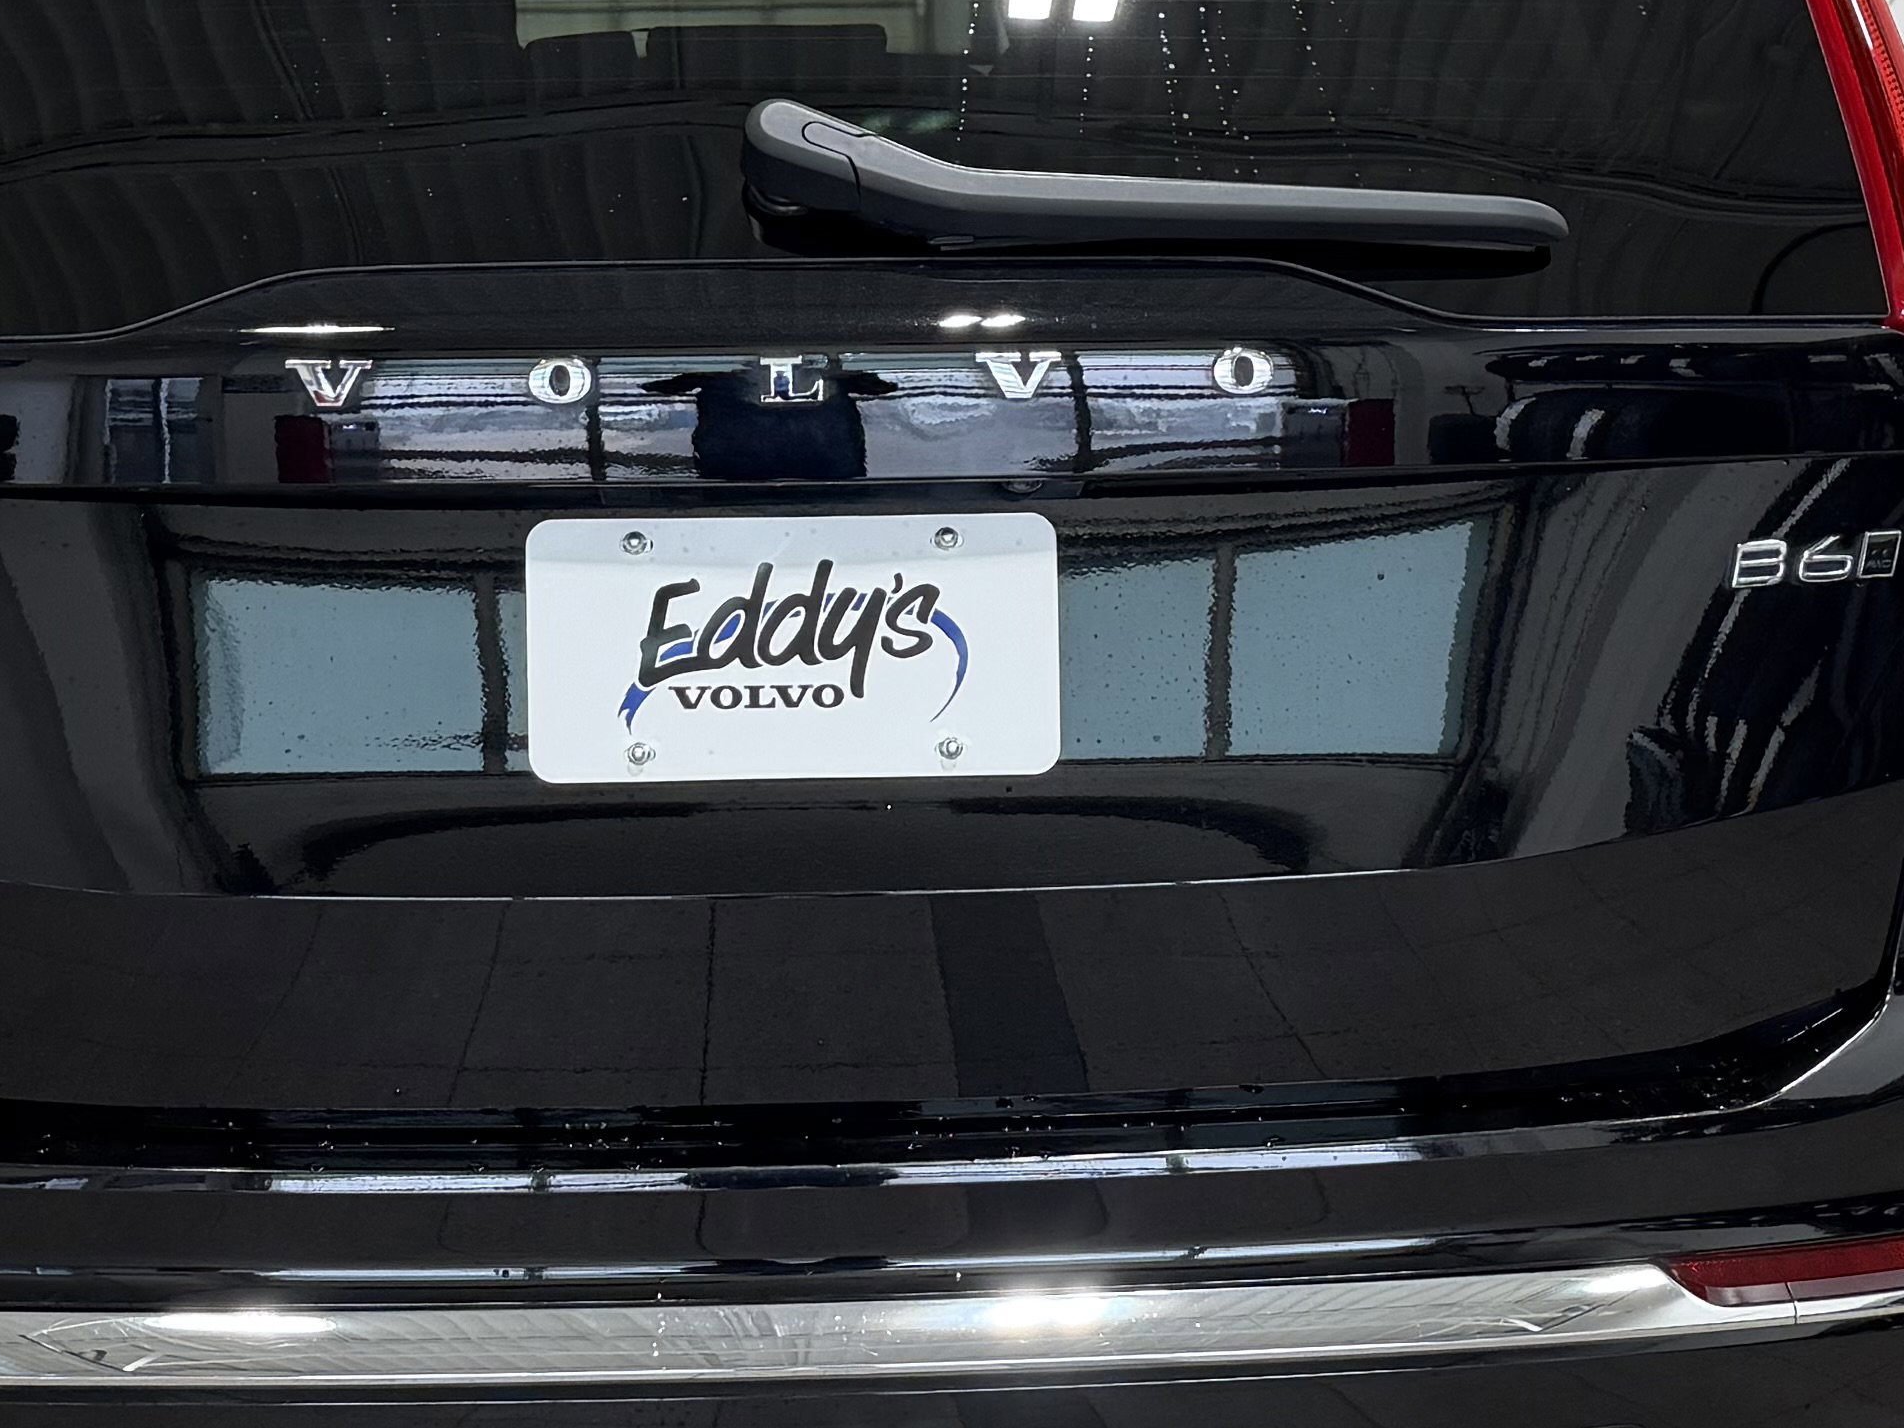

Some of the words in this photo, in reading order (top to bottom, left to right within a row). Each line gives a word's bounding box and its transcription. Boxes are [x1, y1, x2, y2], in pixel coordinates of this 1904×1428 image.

[284, 347, 1276, 408] VOLVO
[1732, 535, 1854, 588] B6
[637, 559, 941, 698] Eddy's
[668, 682, 846, 709] VOLVO
